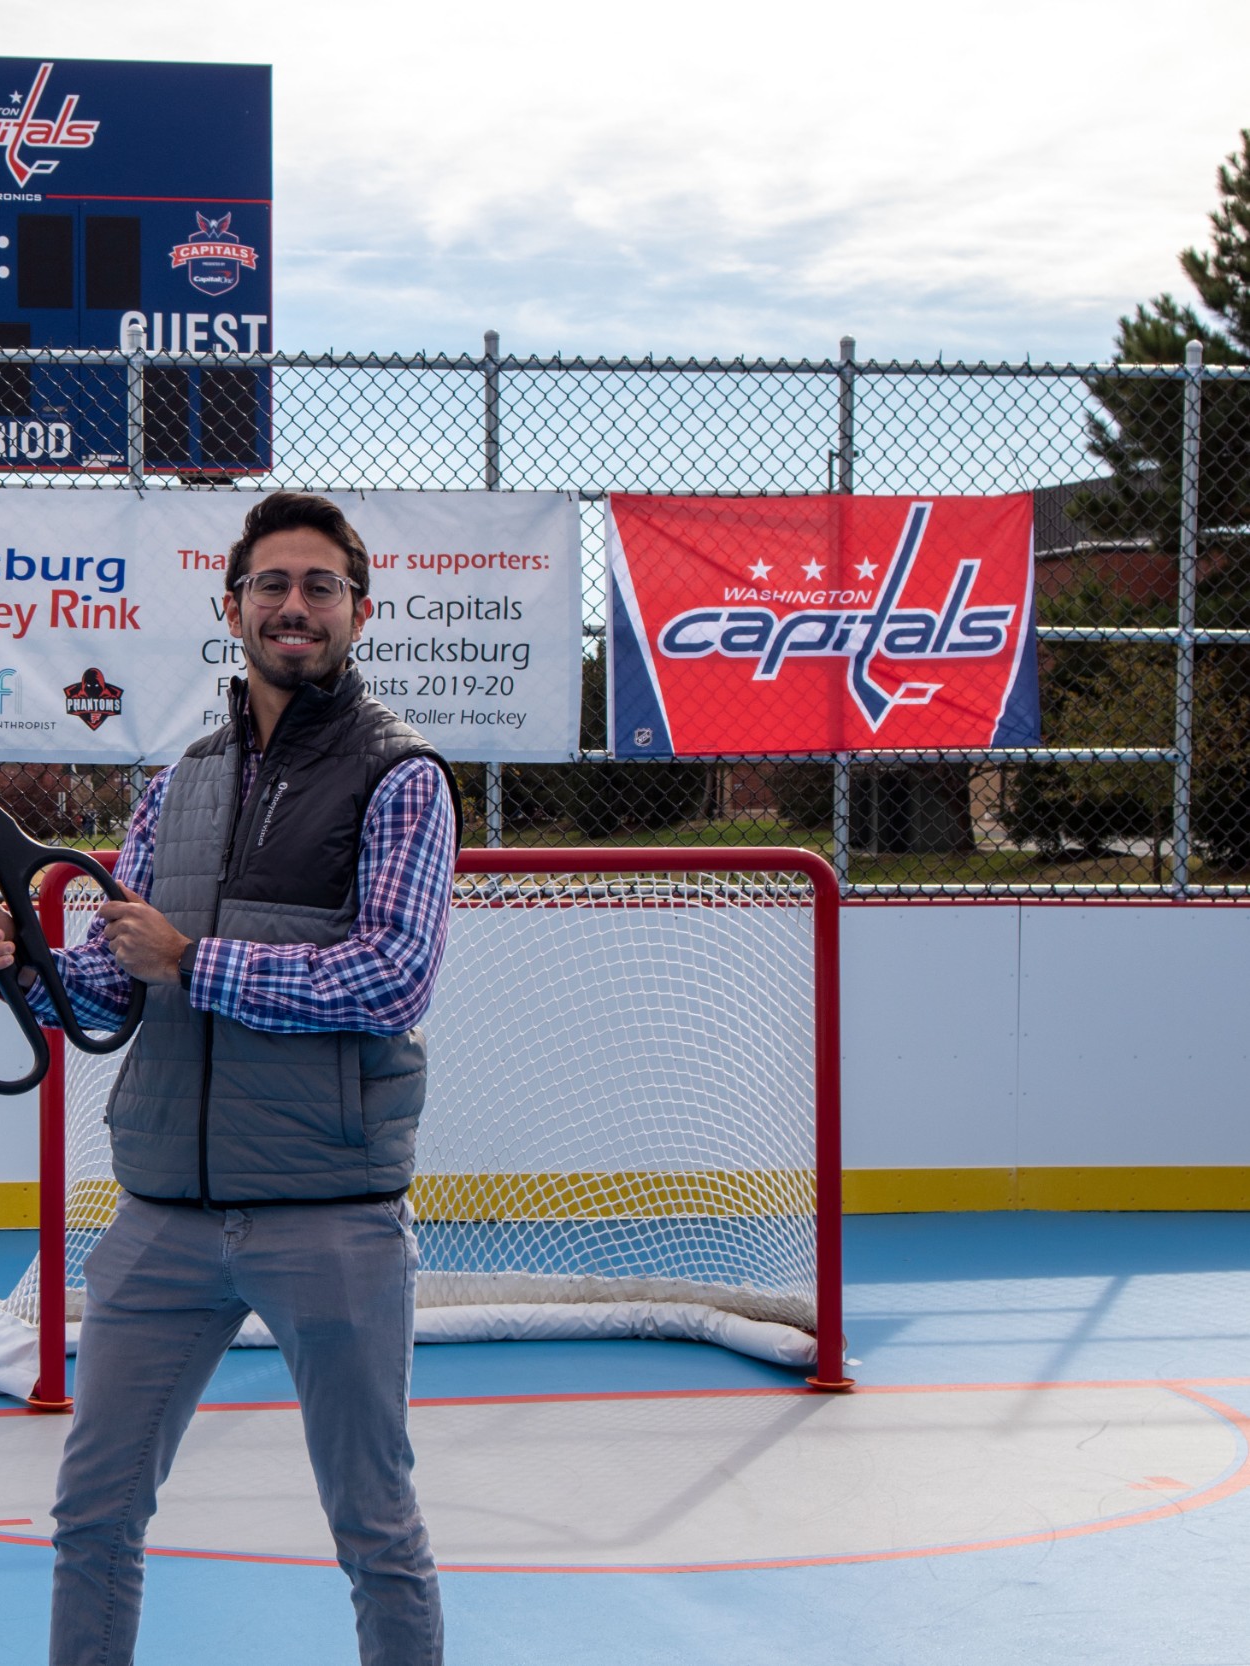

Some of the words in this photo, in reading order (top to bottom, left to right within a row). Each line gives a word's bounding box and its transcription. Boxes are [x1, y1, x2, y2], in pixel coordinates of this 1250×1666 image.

[180, 246, 249, 258] CAPITALS
[120, 310, 268, 353] GUEST
[177, 549, 226, 570] Tha
[406, 551, 550, 575] supporters:
[723, 587, 873, 605] WASHINGTON
[50, 589, 141, 630] Rink
[406, 595, 523, 627] Capitals
[350, 637, 531, 671] dericksburg
[416, 675, 515, 697] 2019-20
[67, 698, 121, 711] PHANTOMS
[404, 708, 456, 725] Roller
[460, 709, 528, 730] Hockey
[265, 790, 283, 823] vineyard
[258, 825, 268, 846] vines
